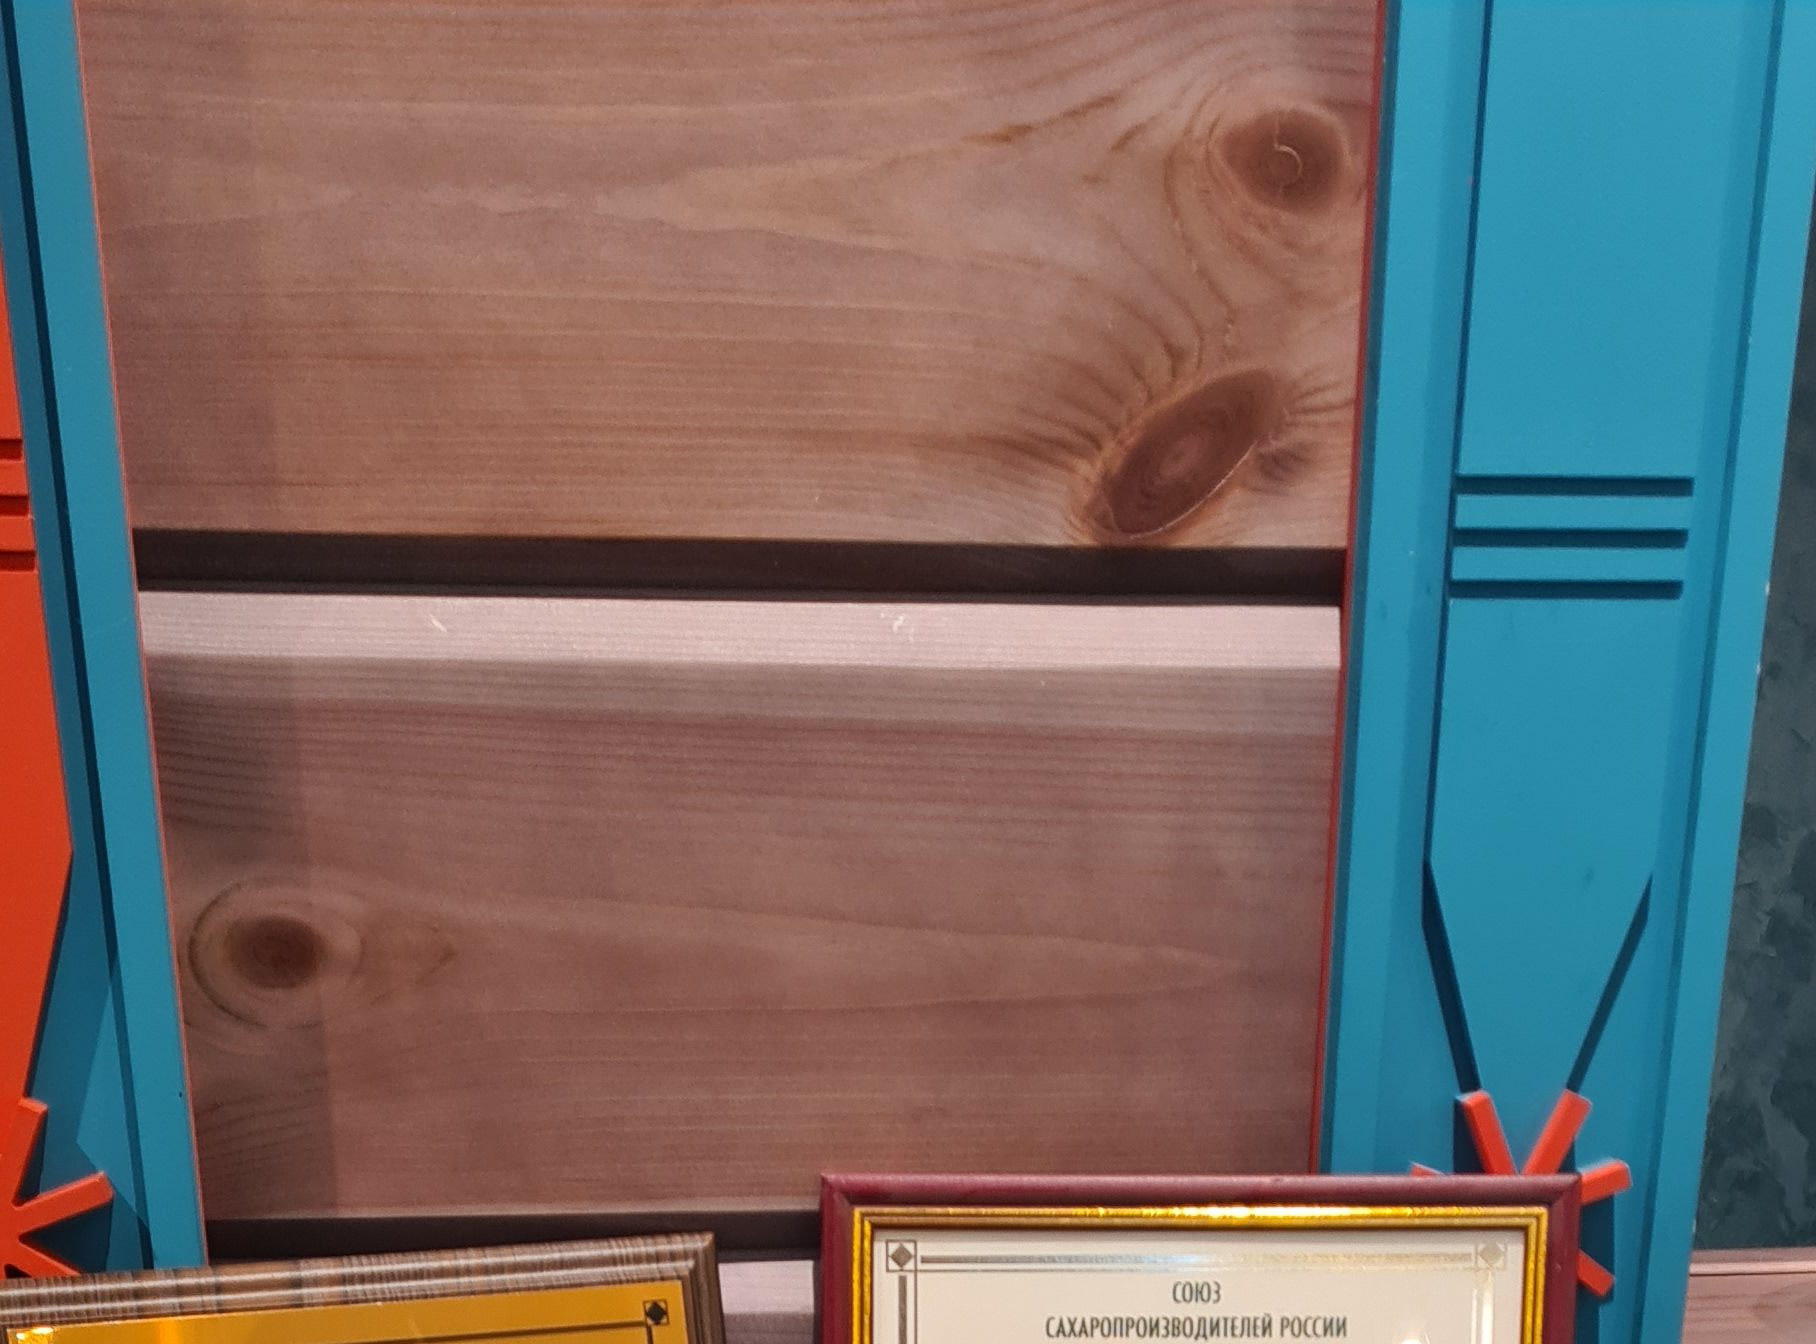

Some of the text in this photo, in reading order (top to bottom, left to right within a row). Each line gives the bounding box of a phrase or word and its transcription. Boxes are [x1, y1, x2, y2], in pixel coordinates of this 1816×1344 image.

[1172, 1281, 1221, 1304] СОЮЗ
[1046, 1313, 1348, 1341] САХАРОПРОИЗВОДИТЕЛЕЙ РОССИИ
